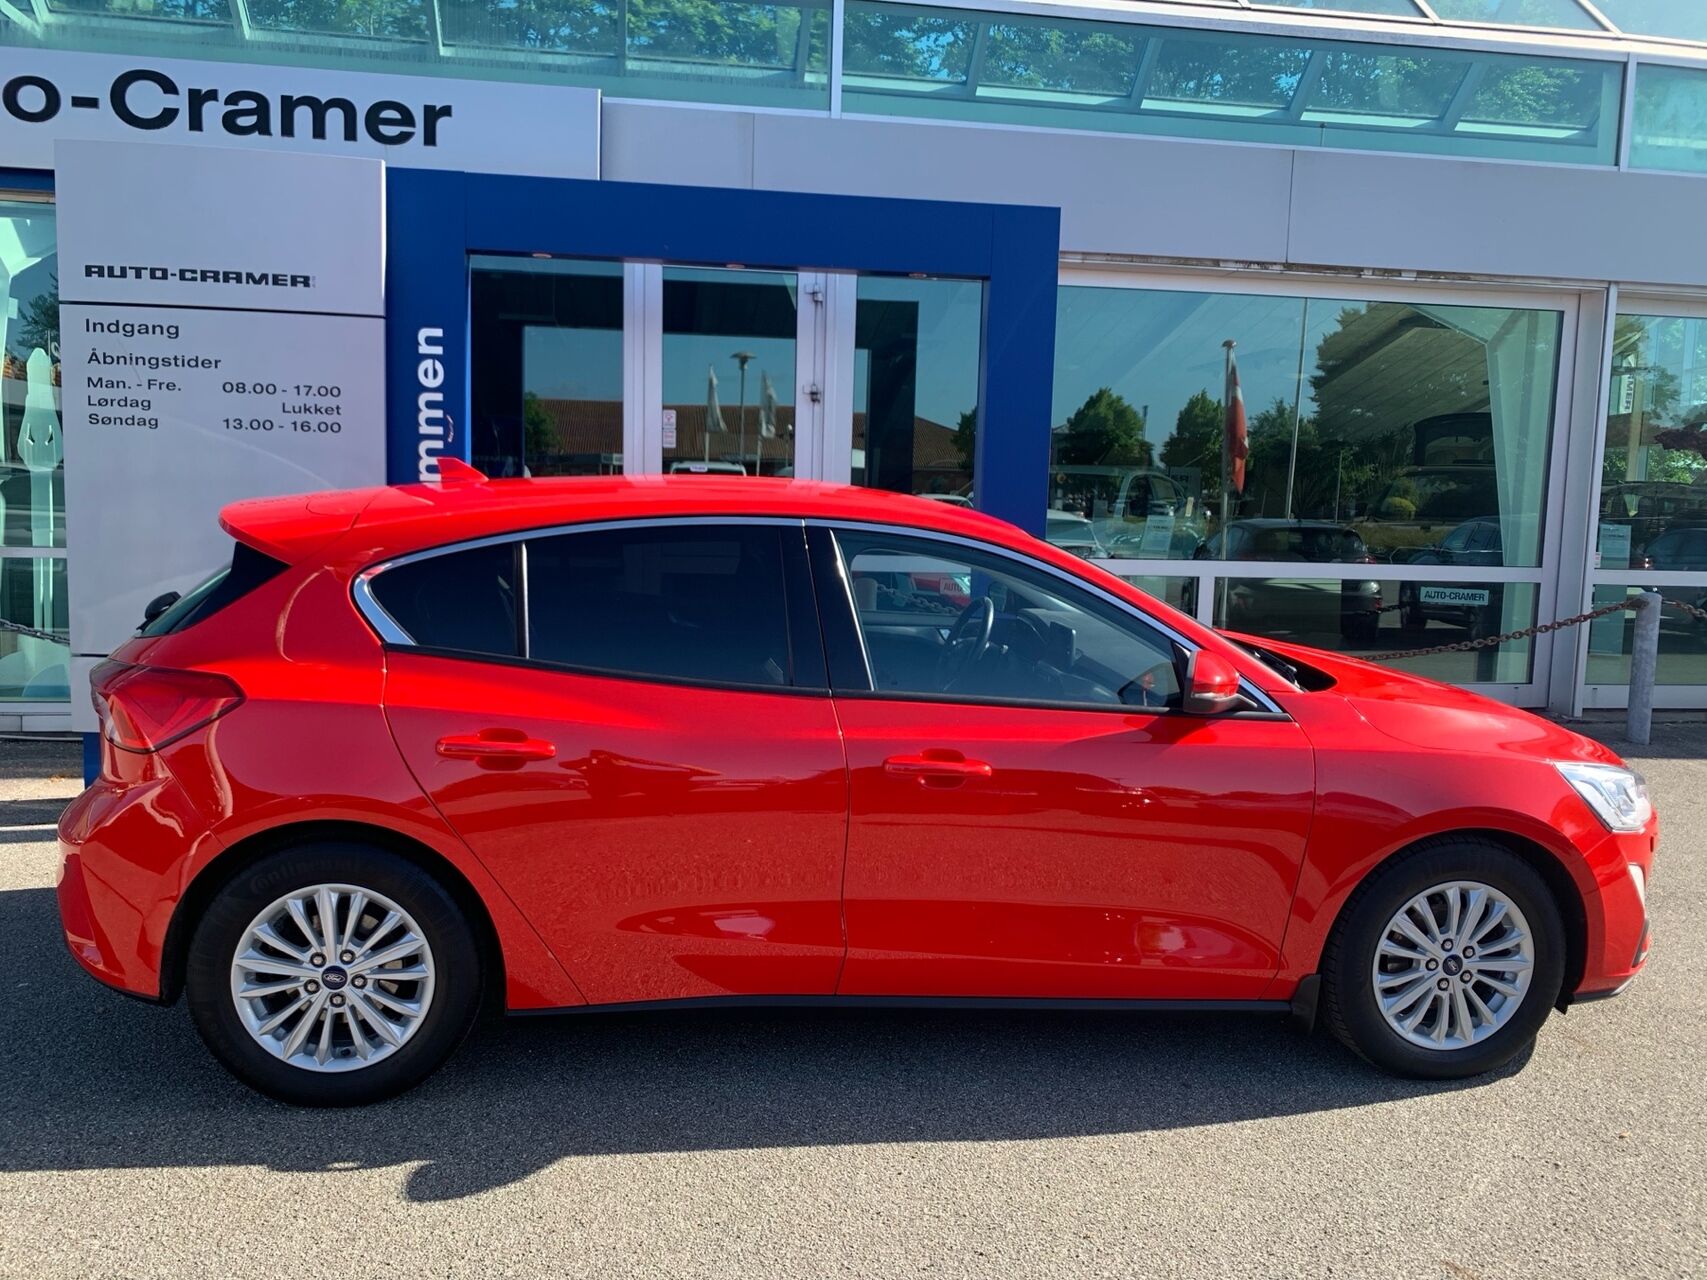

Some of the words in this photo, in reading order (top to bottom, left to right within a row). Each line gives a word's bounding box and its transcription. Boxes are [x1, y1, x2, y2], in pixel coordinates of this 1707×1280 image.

[2, 69, 452, 147] o-Cramer
[84, 264, 311, 288] AUTO-CRAMER
[85, 318, 180, 339] Indgang
[87, 348, 222, 369] Åbningstider
[87, 376, 132, 390] Man.
[147, 379, 182, 392] Fre.
[222, 381, 277, 395] 08.00
[293, 384, 341, 398] 17.00
[87, 395, 151, 410] Lørdag
[282, 402, 342, 416] Lukket
[88, 413, 159, 429] Søndag
[222, 418, 275, 432] 13.00
[290, 421, 342, 434] 16.00
[1424, 590, 1486, 602] AUTO-CRAMER
